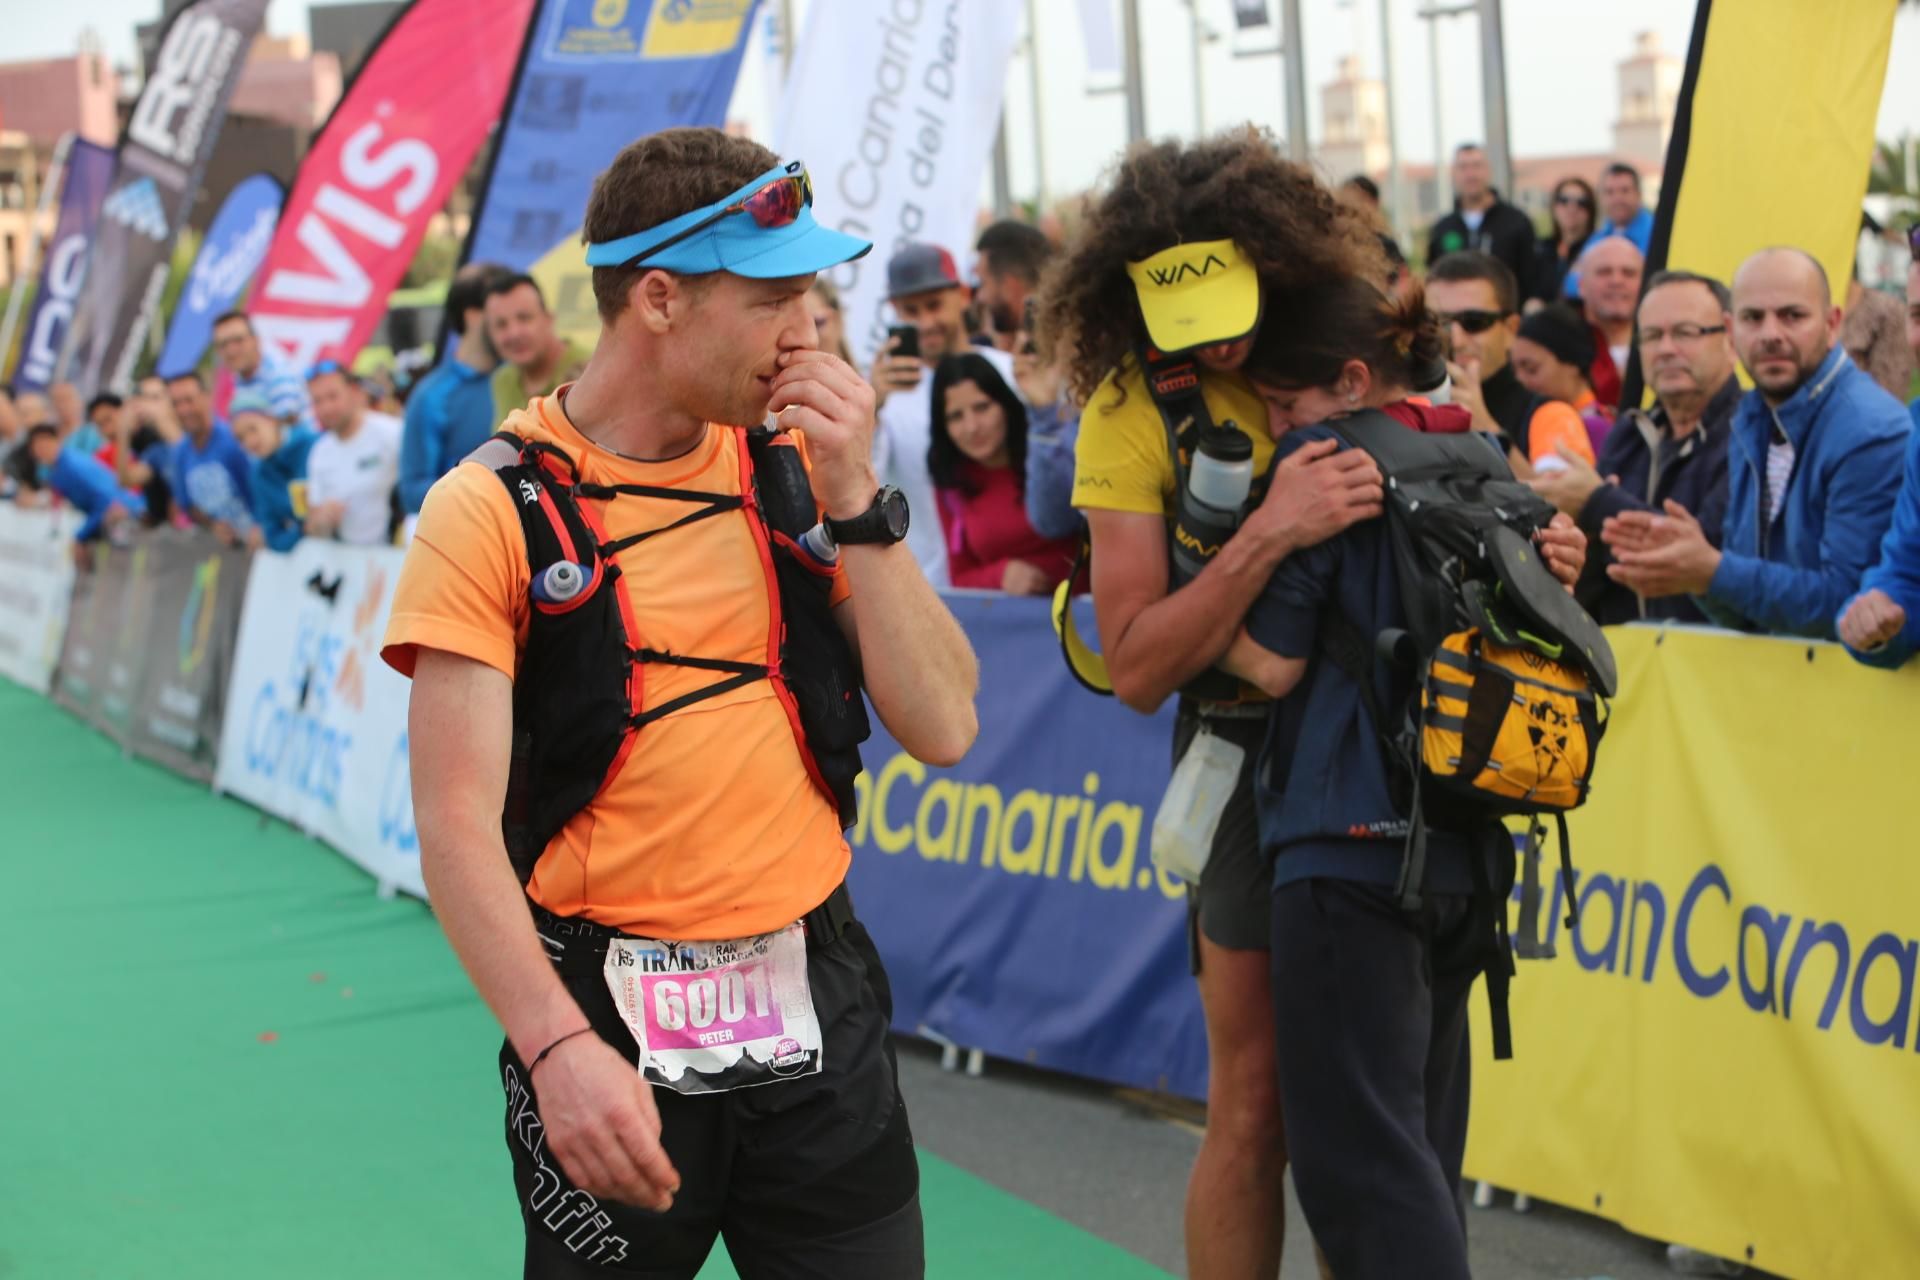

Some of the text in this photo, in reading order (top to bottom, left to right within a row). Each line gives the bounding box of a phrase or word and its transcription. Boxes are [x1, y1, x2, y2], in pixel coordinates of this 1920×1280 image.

[250, 121, 439, 372] AVIS
[653, 962, 771, 1031] 6001
[1493, 832, 1920, 1054] ranCana
[699, 1029, 734, 1046] PETER
